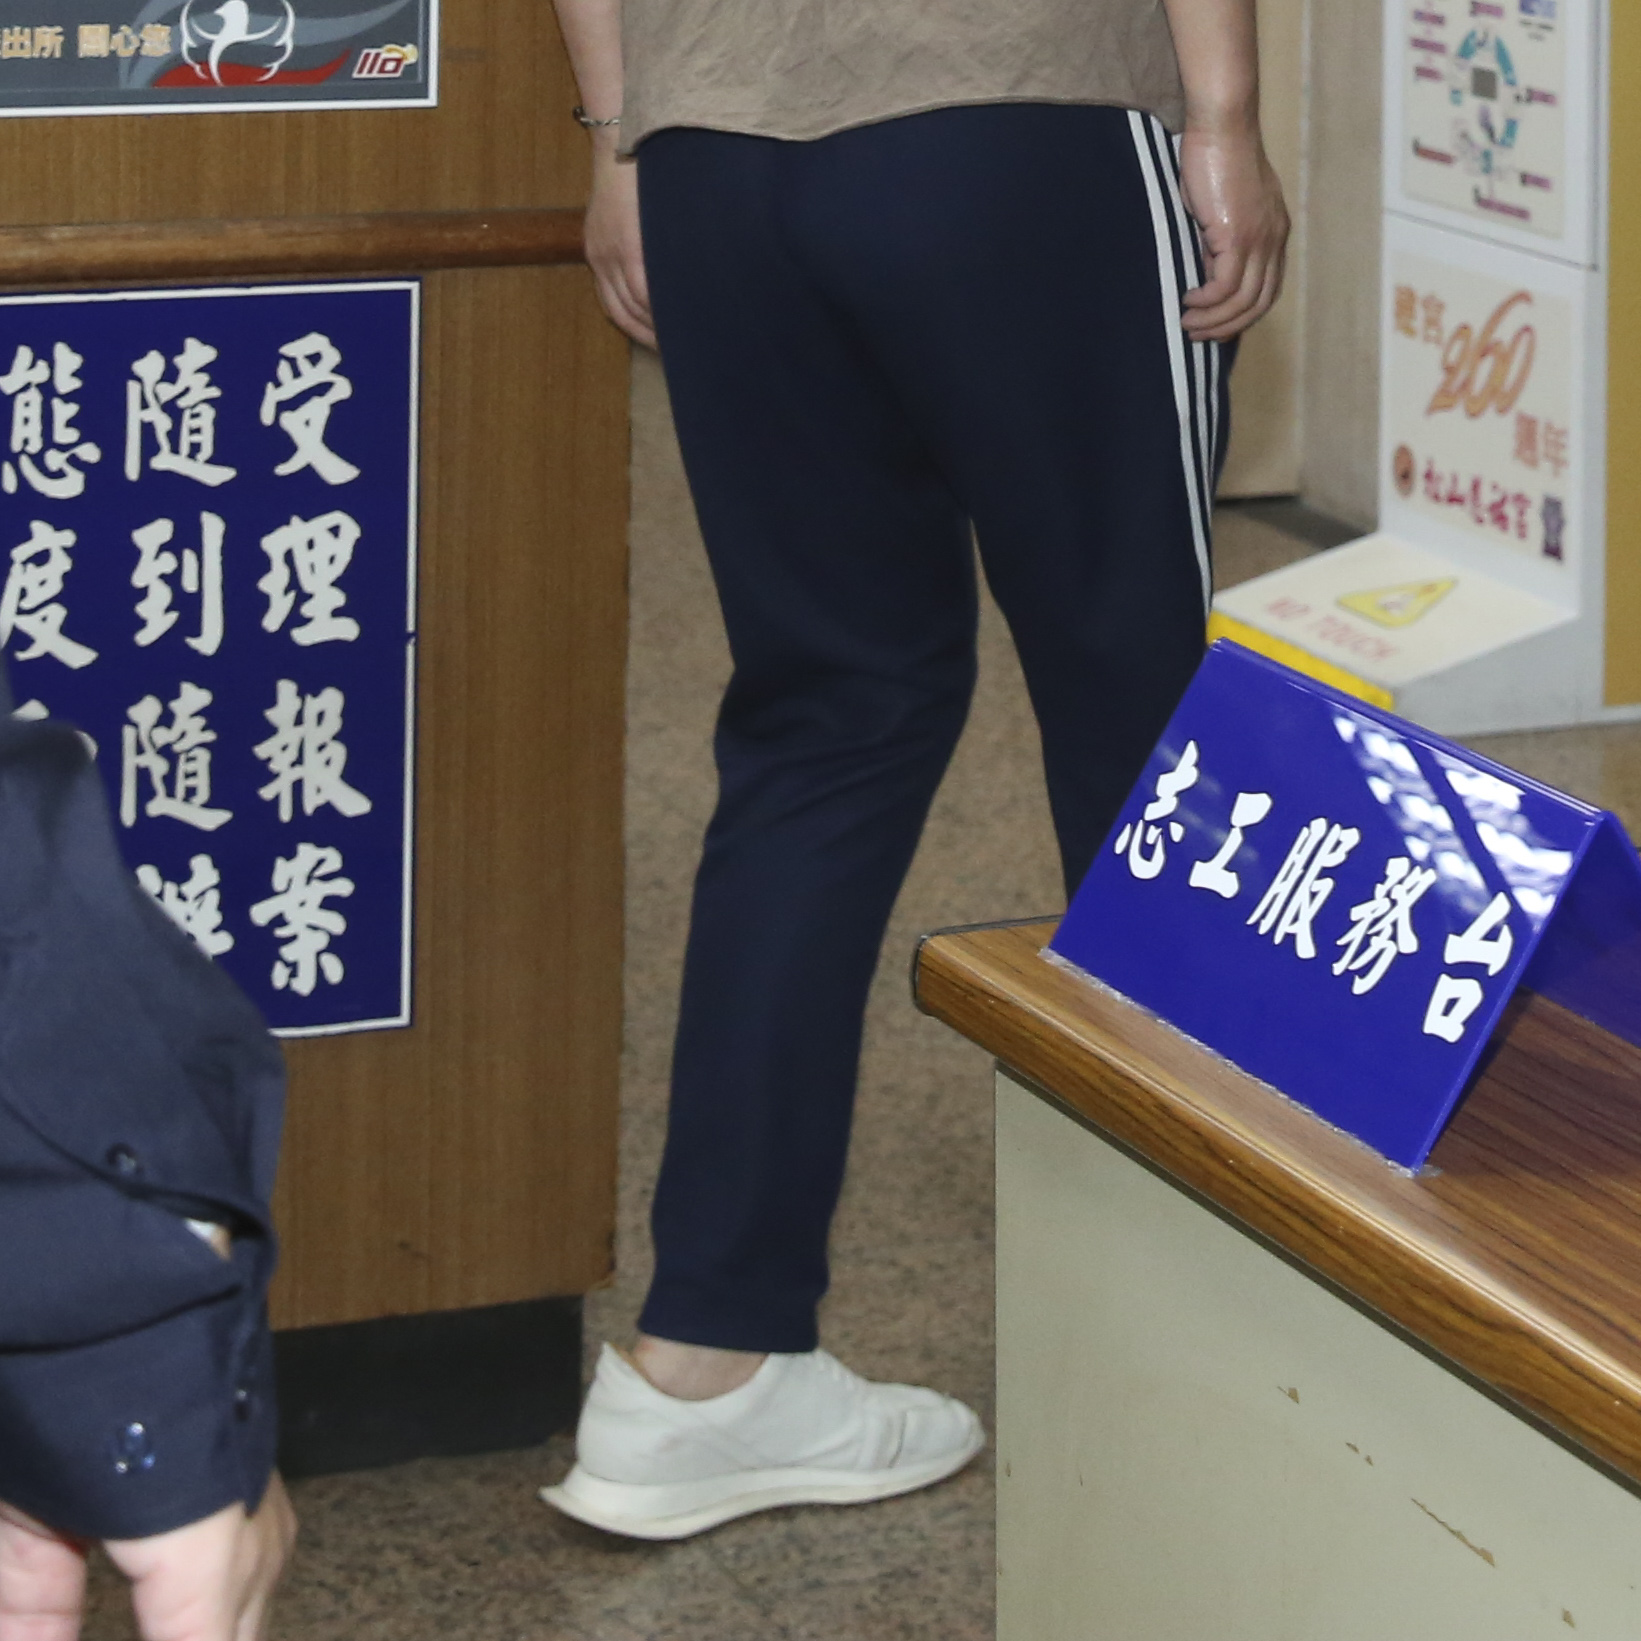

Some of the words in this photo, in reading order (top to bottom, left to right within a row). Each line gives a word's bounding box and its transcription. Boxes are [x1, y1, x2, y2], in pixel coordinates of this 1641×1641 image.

[249, 332, 372, 997] 受理報案
[1114, 740, 1514, 1043] 志工服務台
